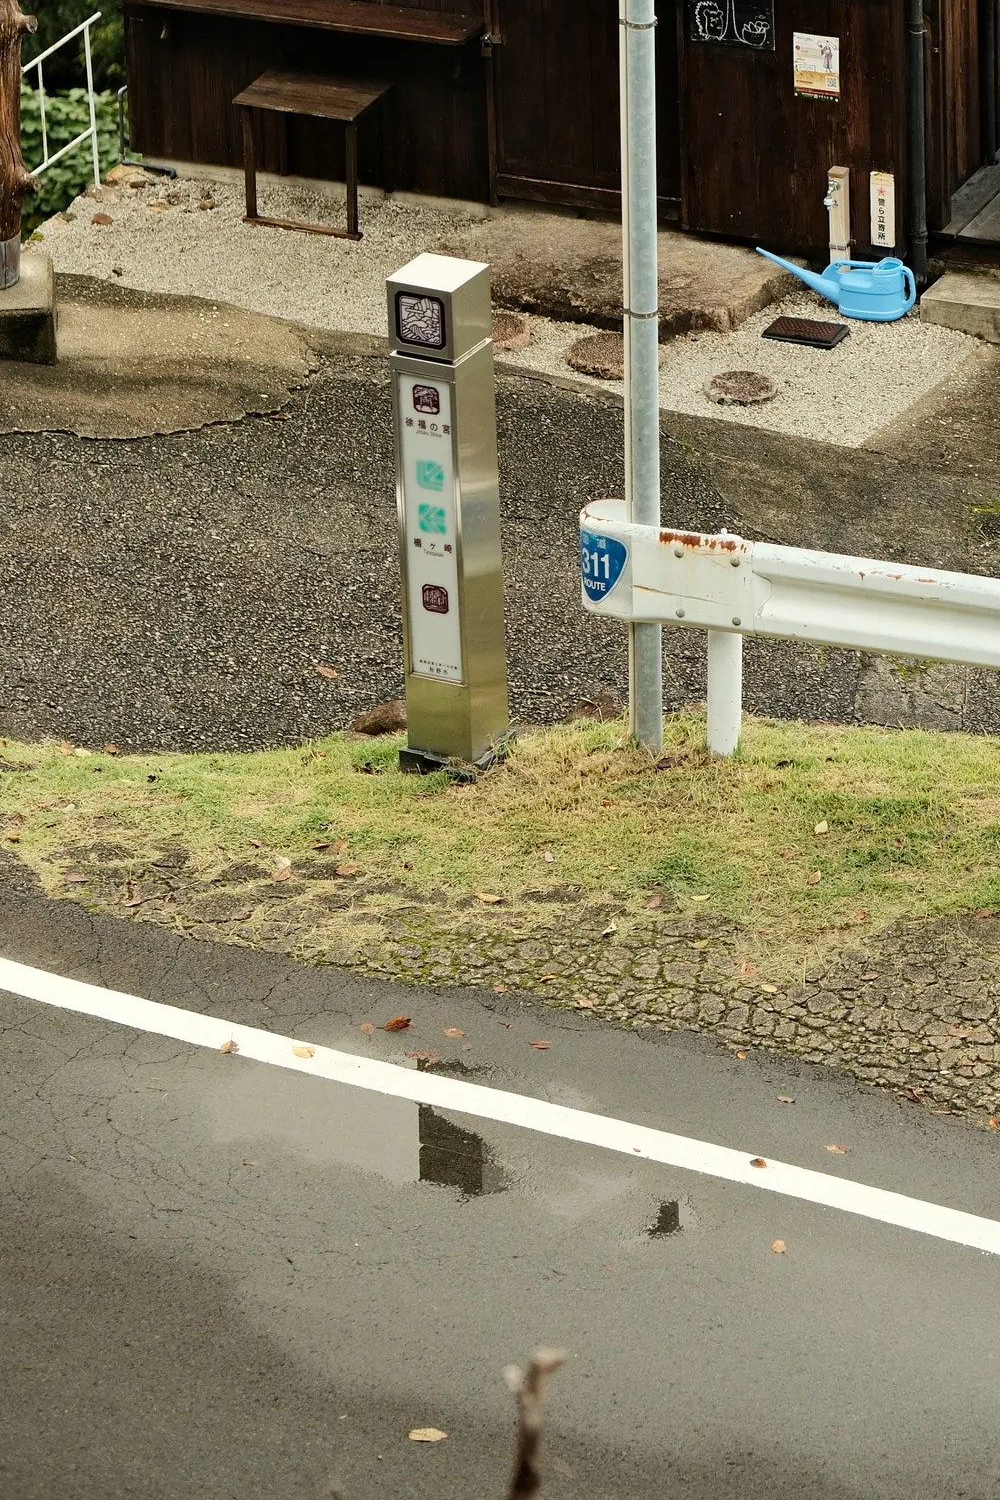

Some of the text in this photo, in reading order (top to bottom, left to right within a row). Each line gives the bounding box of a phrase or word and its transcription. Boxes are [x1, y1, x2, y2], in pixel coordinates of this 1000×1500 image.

[405, 417, 450, 435] 徐福の宮
[582, 547, 610, 579] 311
[583, 577, 607, 592] ROUTE
